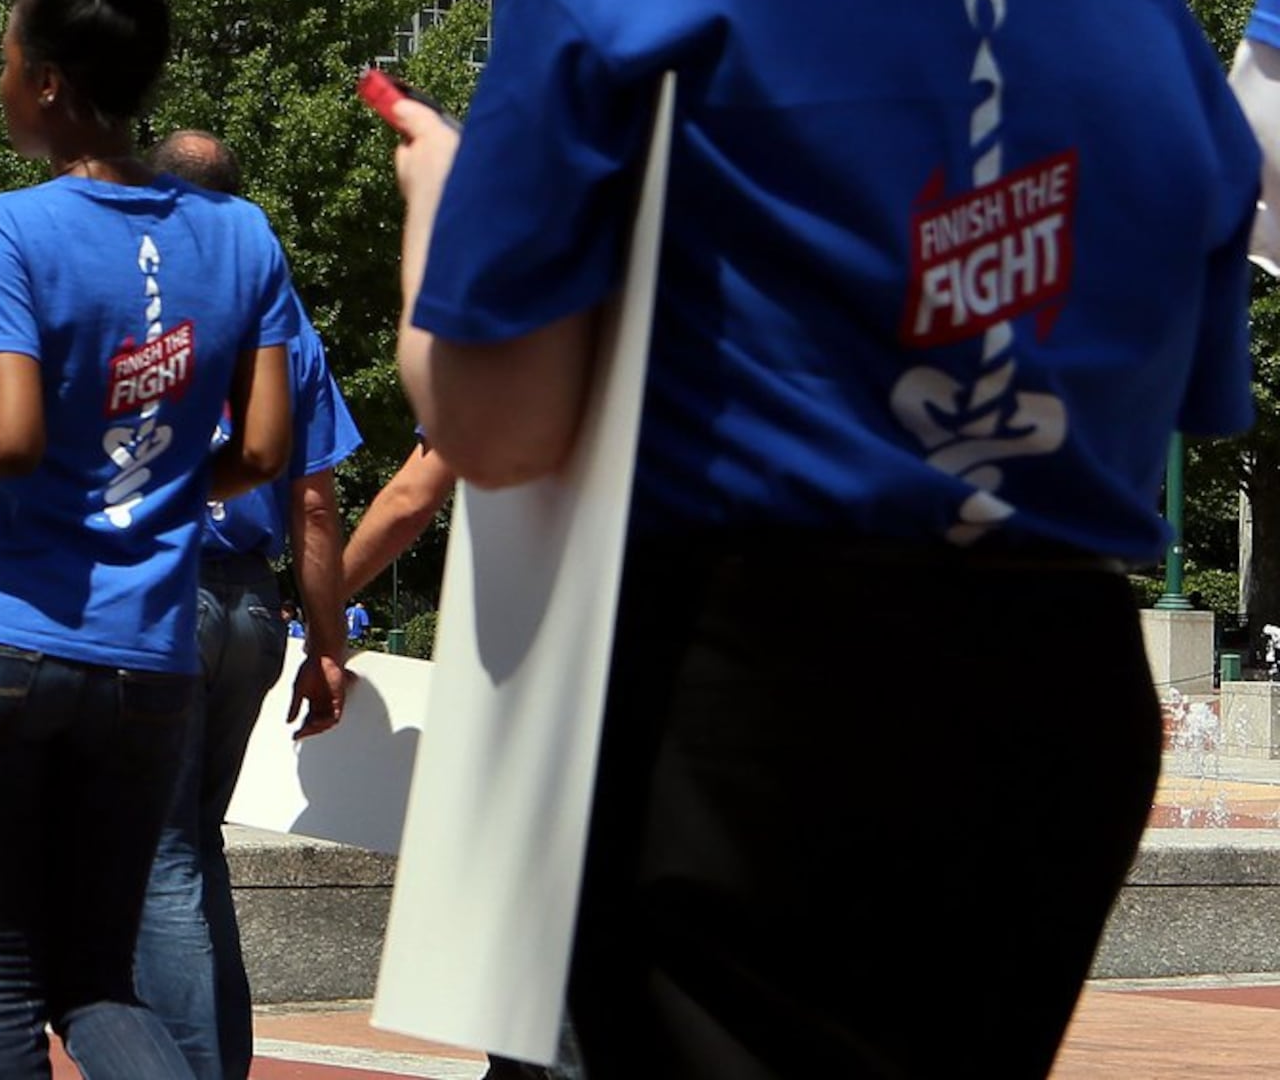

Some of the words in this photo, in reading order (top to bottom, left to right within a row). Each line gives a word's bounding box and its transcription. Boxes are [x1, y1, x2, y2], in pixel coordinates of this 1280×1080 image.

[919, 191, 1006, 261] FINISH
[1008, 163, 1069, 219] THE
[913, 213, 1064, 336] FIGHT
[111, 347, 191, 411] FIGHT
[114, 341, 162, 379] FINISH
[163, 325, 190, 353] THE
